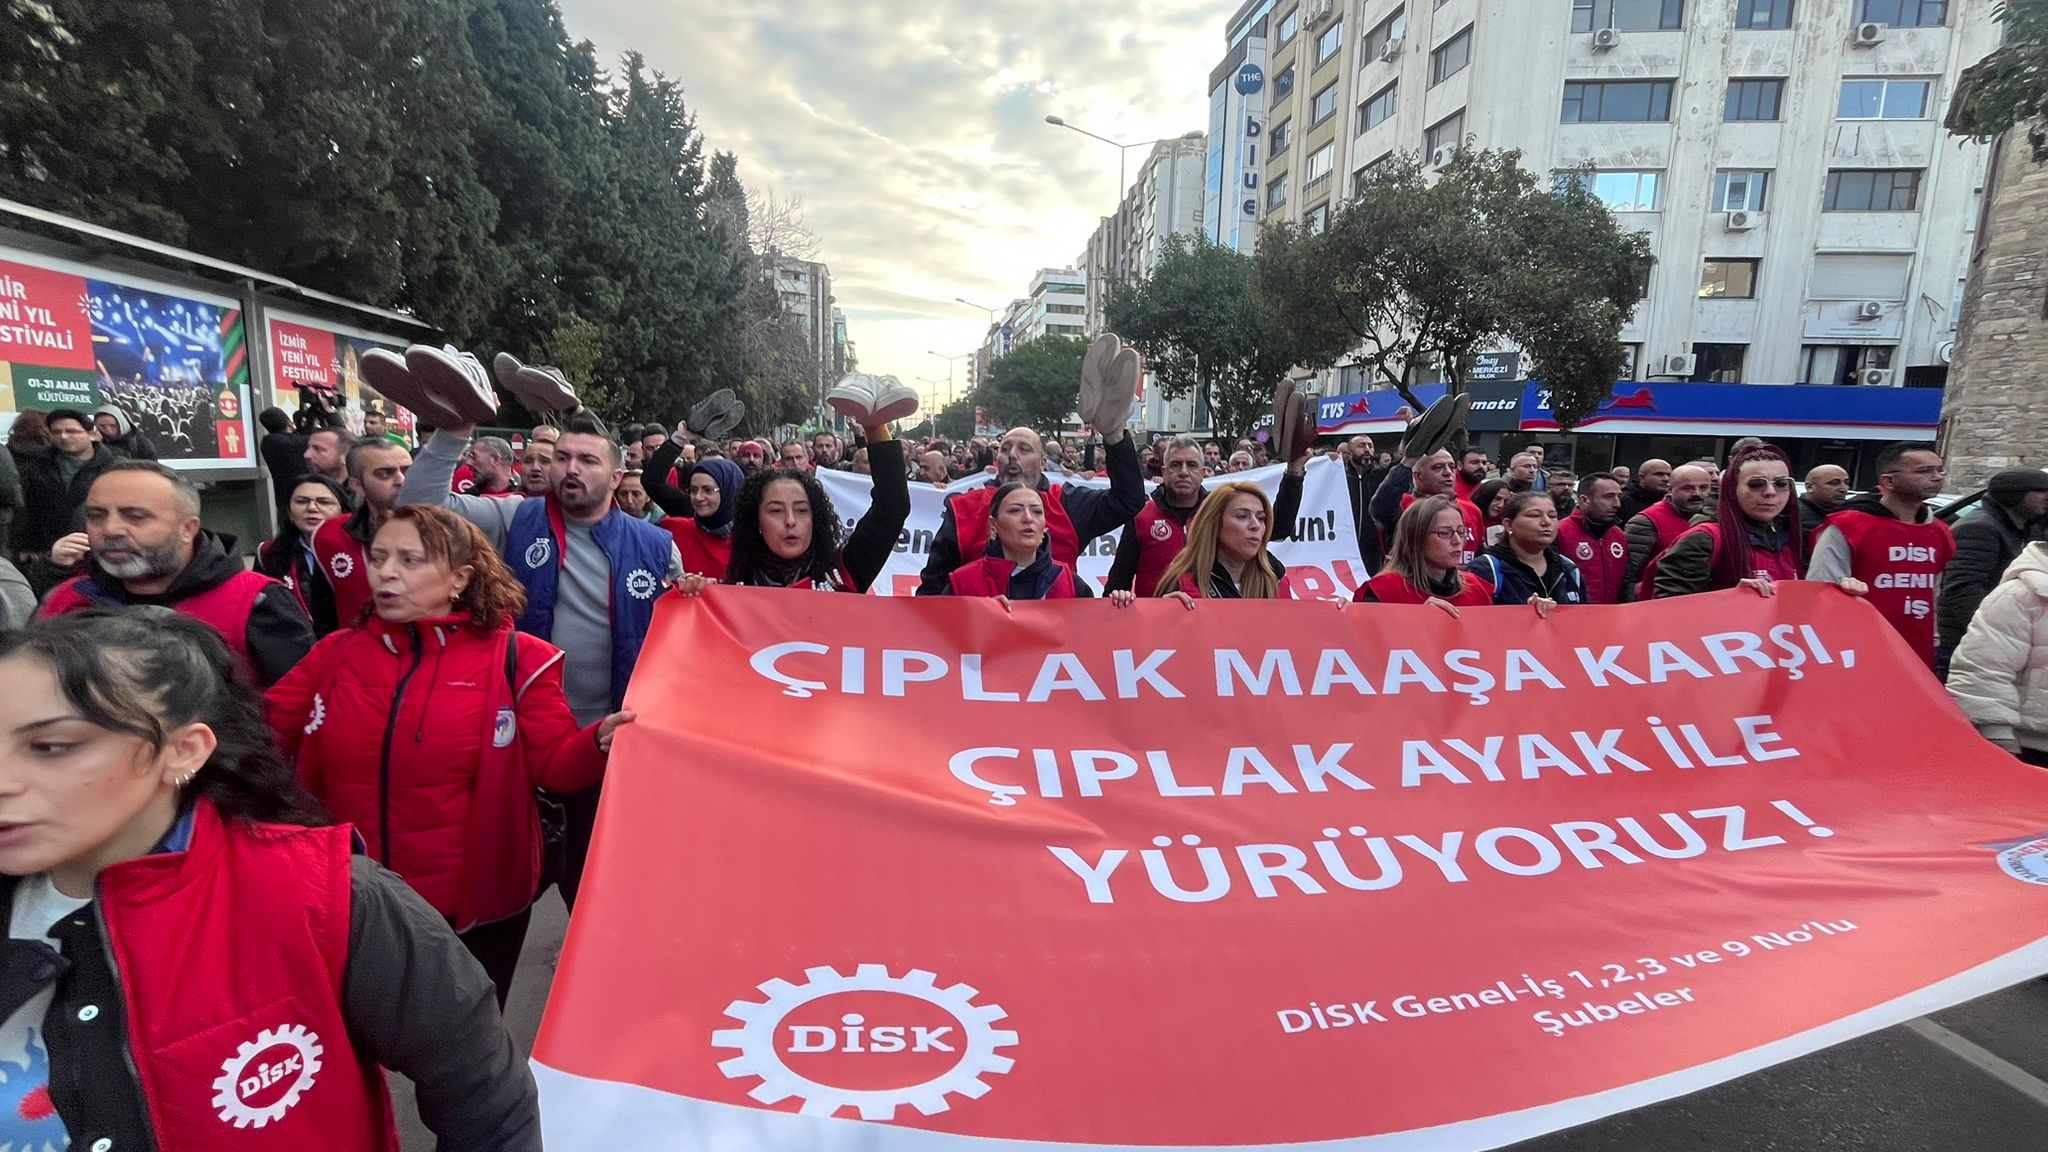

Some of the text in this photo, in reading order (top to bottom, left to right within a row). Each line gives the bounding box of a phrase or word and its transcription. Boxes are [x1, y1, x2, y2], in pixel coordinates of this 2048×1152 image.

[1241, 73, 1261, 82] THE
[1243, 115, 1261, 215] blue
[0, 275, 27, 300] İR
[24, 305, 56, 327] YIL
[279, 330, 307, 349] İZMİR
[281, 350, 320, 367] YENİ YIL
[56, 380, 90, 391] ARALIK
[282, 365, 328, 383] FESTİVALİ
[38, 391, 93, 405] KÜLTÜRPARK
[1321, 402, 1345, 419] TVS
[1874, 573, 1935, 589] GEN
[1904, 595, 1930, 620] İŞ
[750, 624, 1856, 705] ÇIPLAK MAAŞA KARŞI,
[948, 715, 1800, 806] ÇIPLAK AYAK İLE
[1276, 998, 1388, 1034] DİSK
[1392, 972, 1566, 1019] Genel-İş
[1671, 945, 1723, 970] ve
[1721, 939, 1752, 960] 9
[1533, 985, 1697, 1037] Şubeler
[787, 1013, 955, 1053] DİSK
[240, 1053, 303, 1099] DİSK
